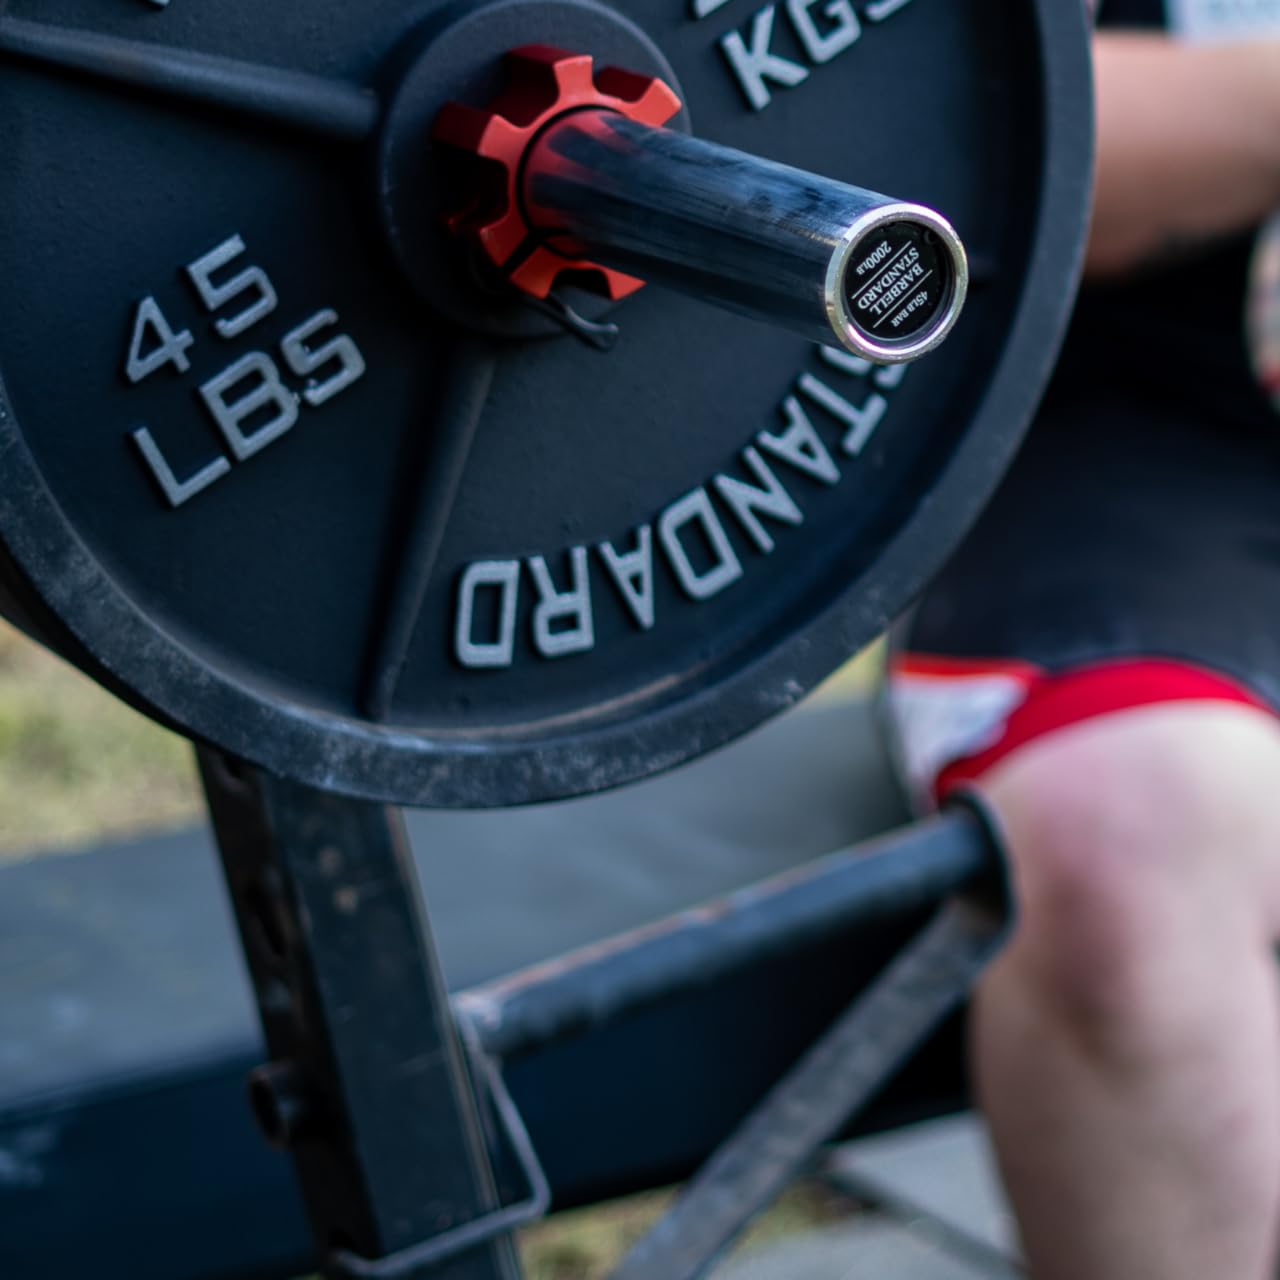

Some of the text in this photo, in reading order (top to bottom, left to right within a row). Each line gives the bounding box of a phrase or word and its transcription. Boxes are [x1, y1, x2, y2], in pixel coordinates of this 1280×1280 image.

[857, 240, 893, 276] 2000LB
[857, 247, 920, 310] STANDARD
[126, 233, 278, 383] 45
[869, 262, 924, 315] BARBELL
[890, 291, 929, 328] 45LB BAR
[133, 308, 366, 508] LBS
